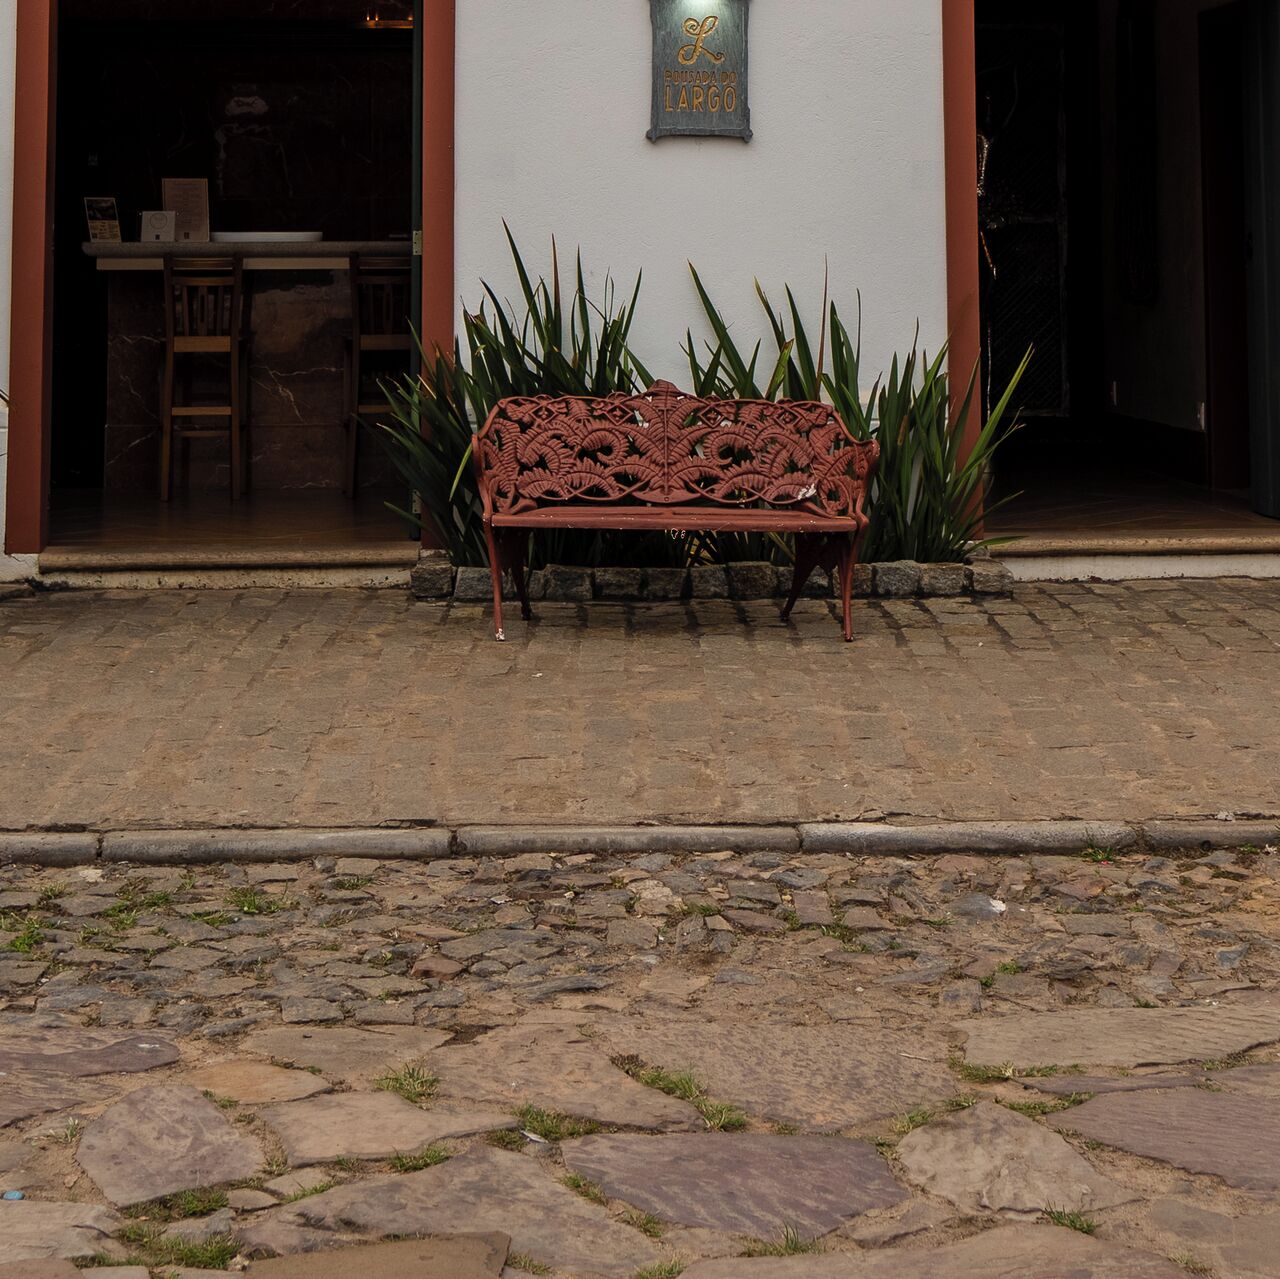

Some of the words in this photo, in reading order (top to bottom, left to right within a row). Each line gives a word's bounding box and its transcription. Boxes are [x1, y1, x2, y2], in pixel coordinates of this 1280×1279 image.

[664, 71, 717, 85] POUSADA
[721, 71, 737, 85] DO
[664, 85, 737, 112] LARGO
